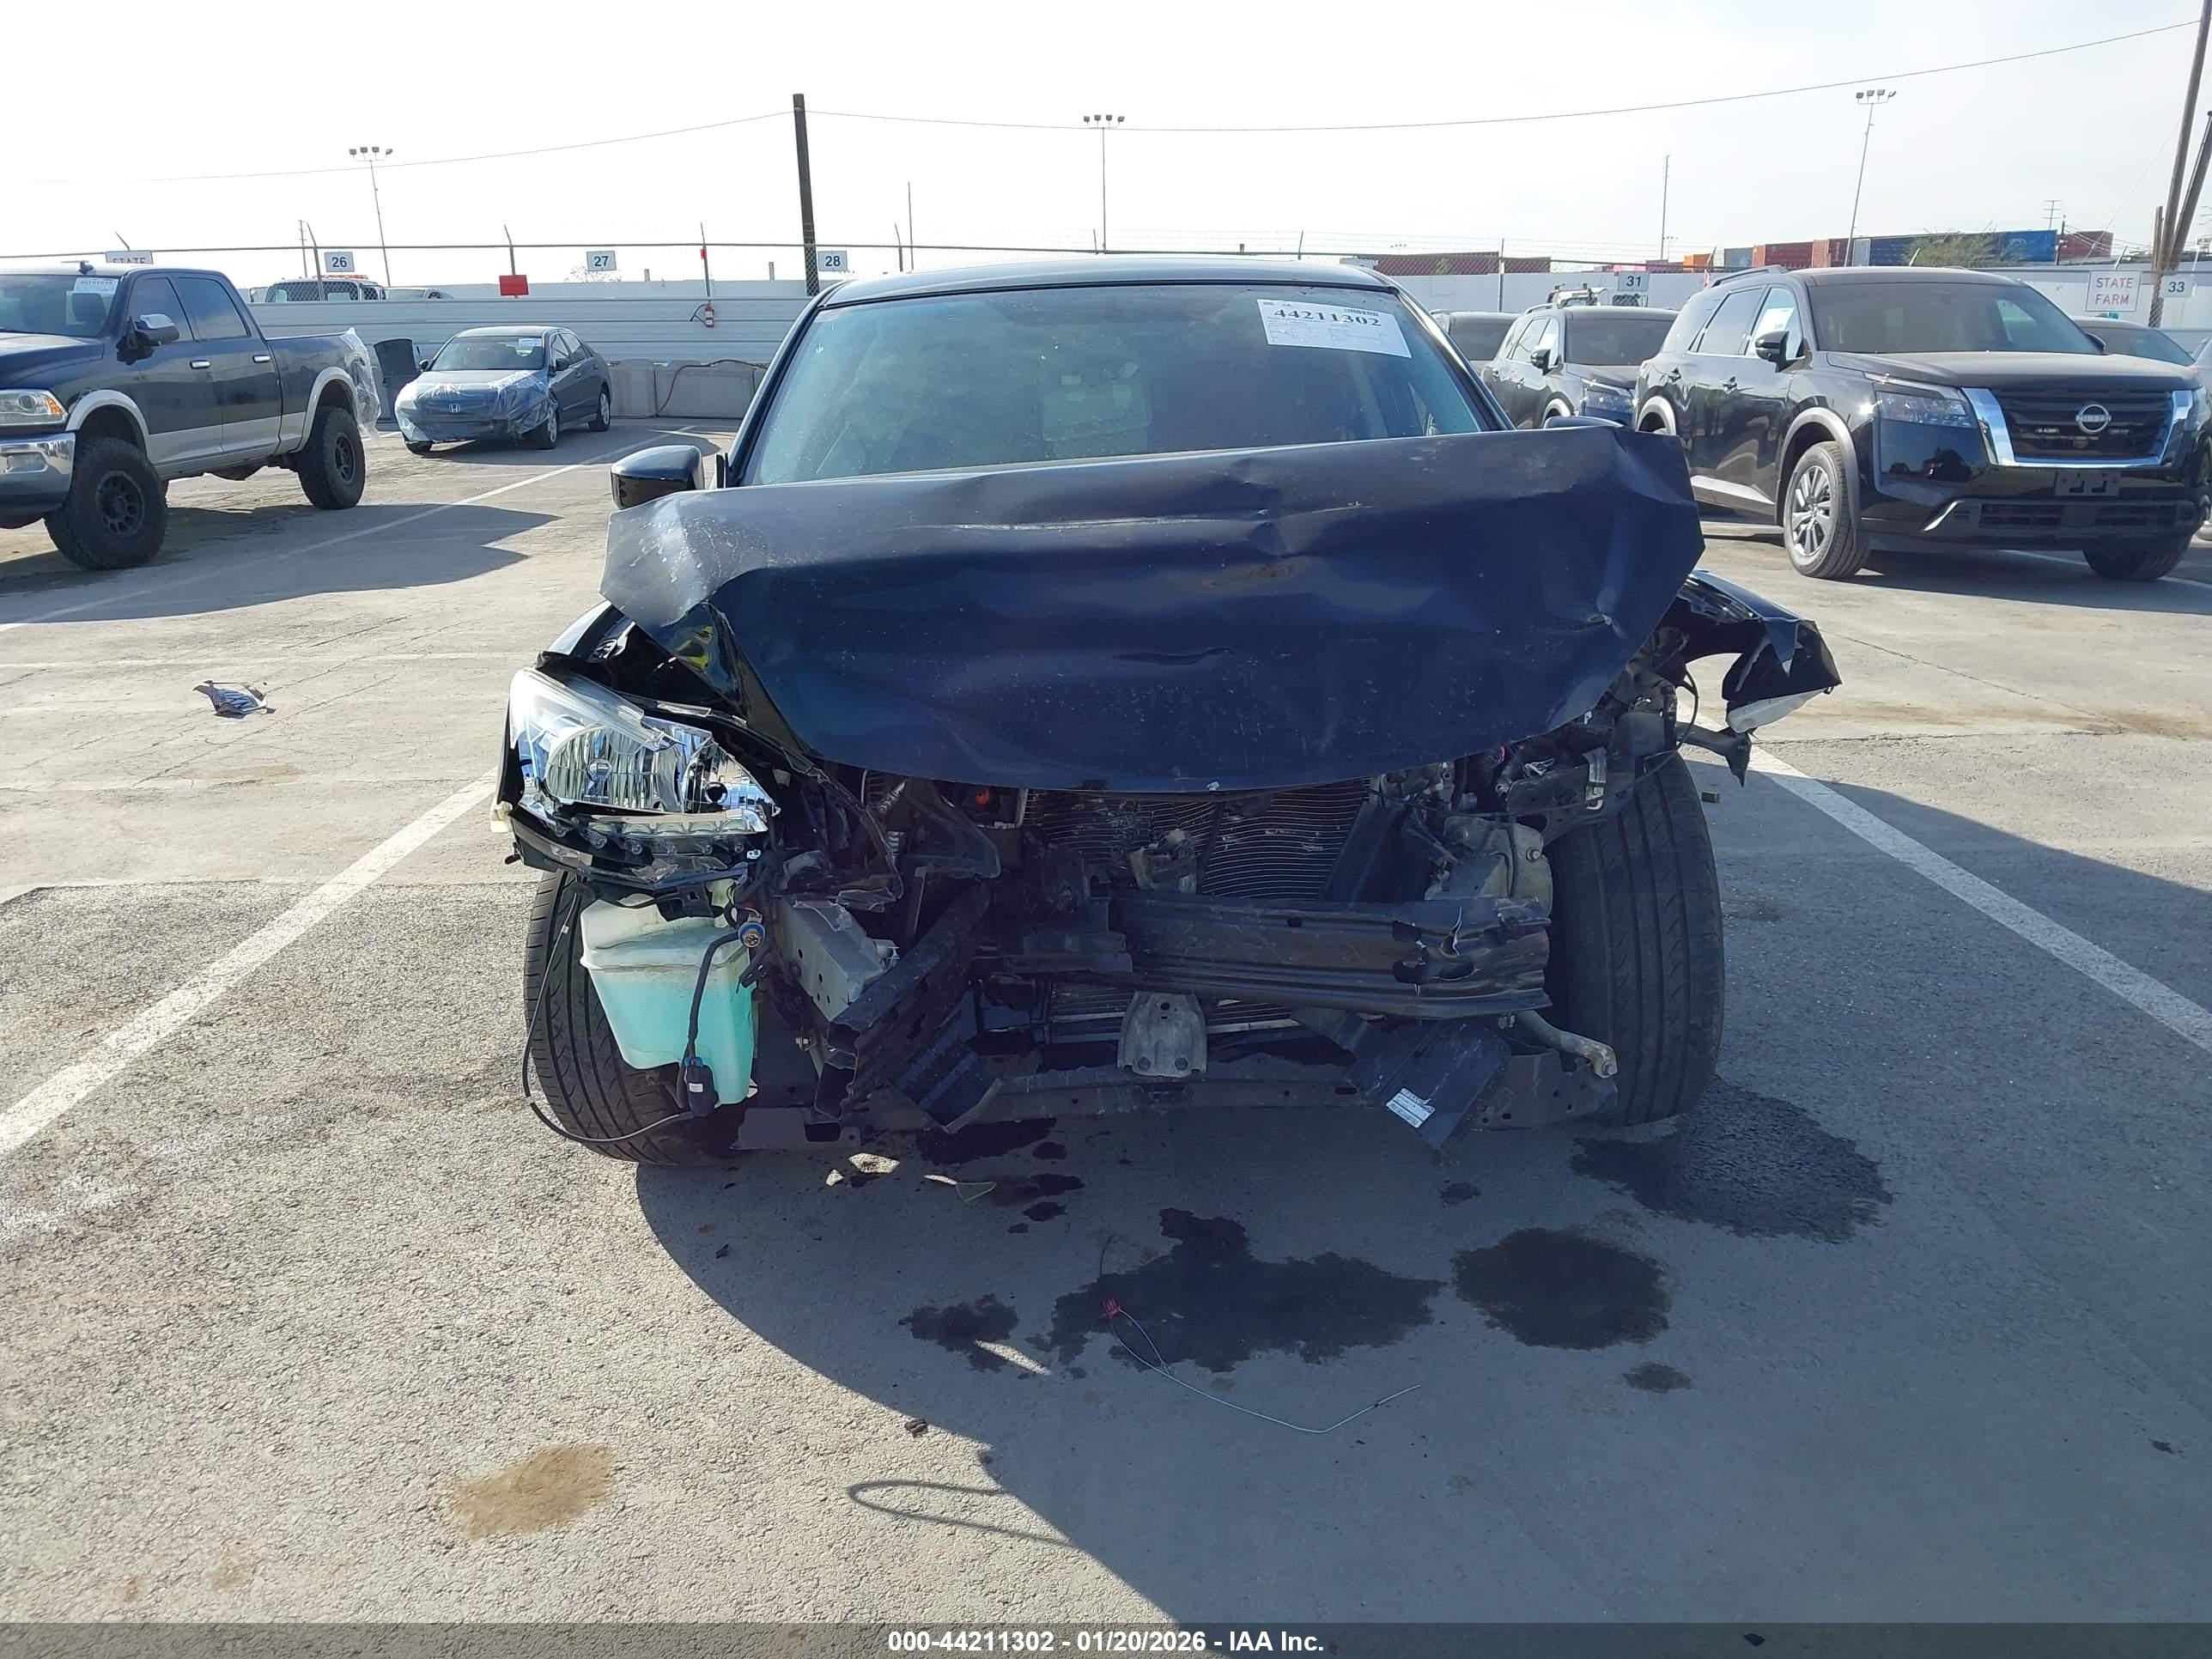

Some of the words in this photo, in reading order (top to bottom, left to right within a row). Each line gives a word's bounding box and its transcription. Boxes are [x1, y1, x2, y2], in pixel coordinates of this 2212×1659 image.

[331, 256, 348, 268] 26
[593, 255, 609, 267] 27
[824, 255, 841, 267] 28
[1626, 275, 1642, 287] 31
[2095, 276, 2134, 289] STATE
[2167, 281, 2185, 293] 33
[2095, 293, 2130, 306] FARM
[1273, 308, 1382, 327] 44211302
[2075, 414, 2112, 423] NISSAN
